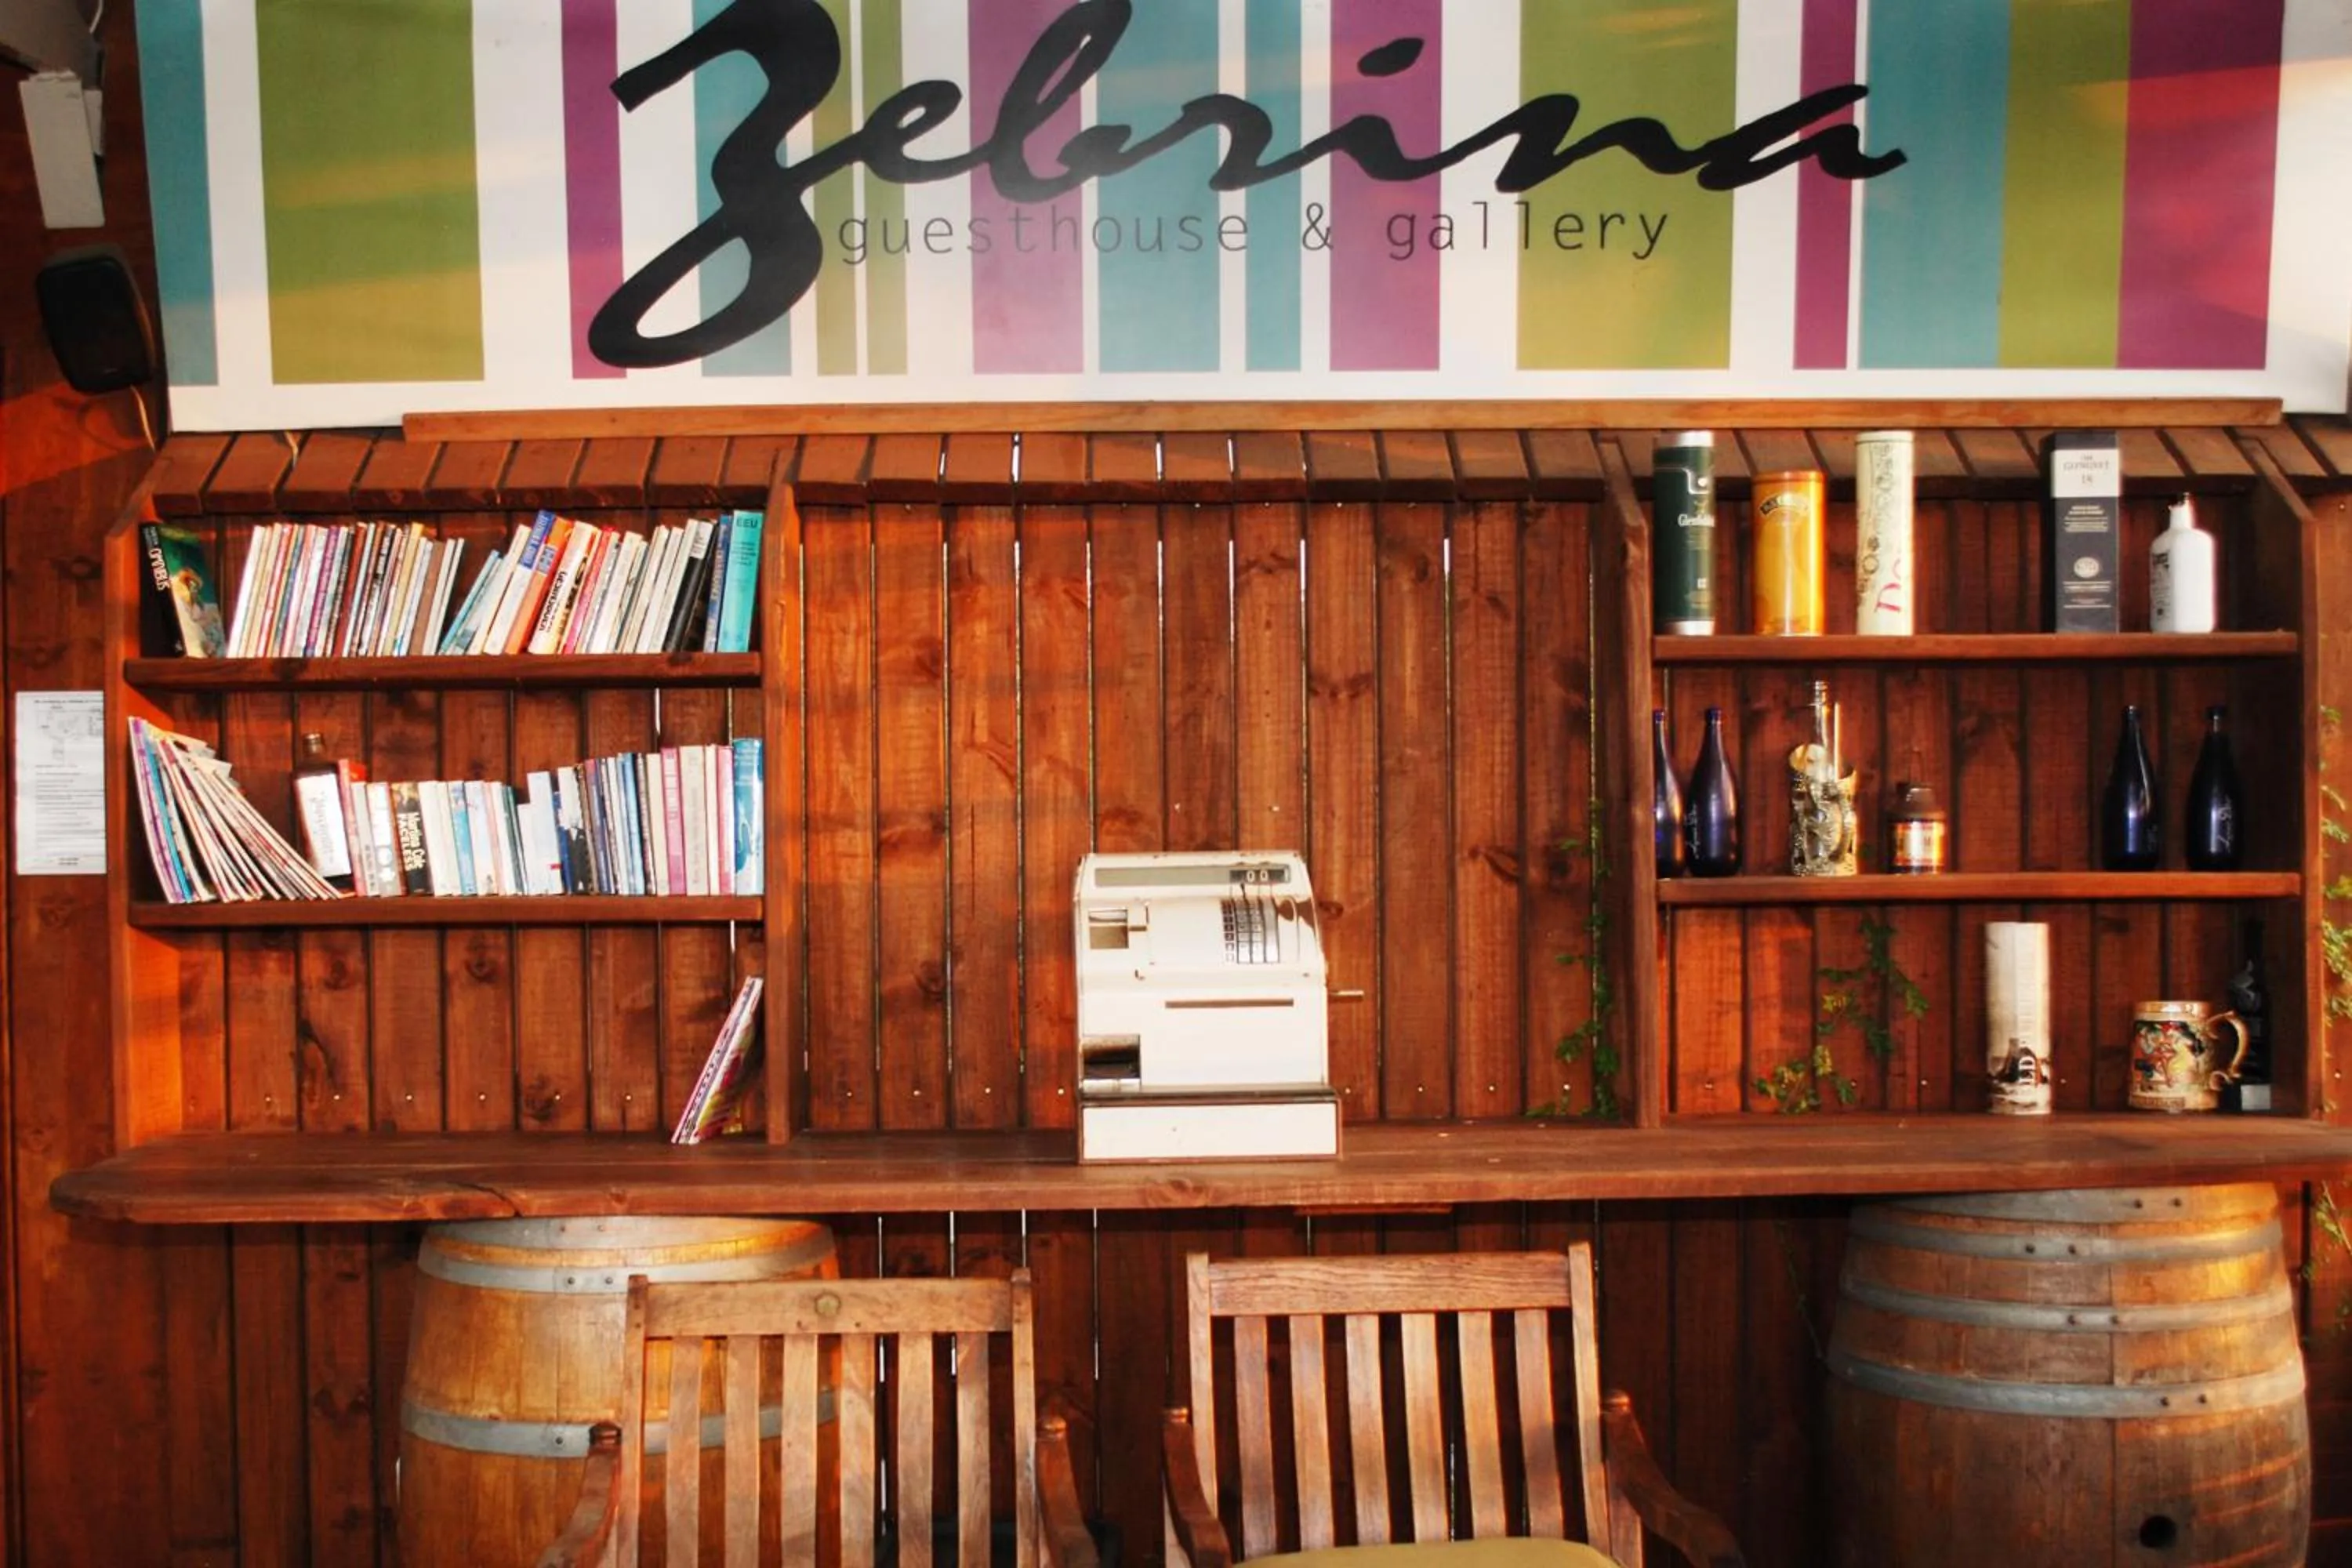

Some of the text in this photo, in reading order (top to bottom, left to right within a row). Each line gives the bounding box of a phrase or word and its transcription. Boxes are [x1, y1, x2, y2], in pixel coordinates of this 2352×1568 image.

[590, 0, 1907, 368] Zebrina
[837, 200, 1668, 266] guesthouse & gallery
